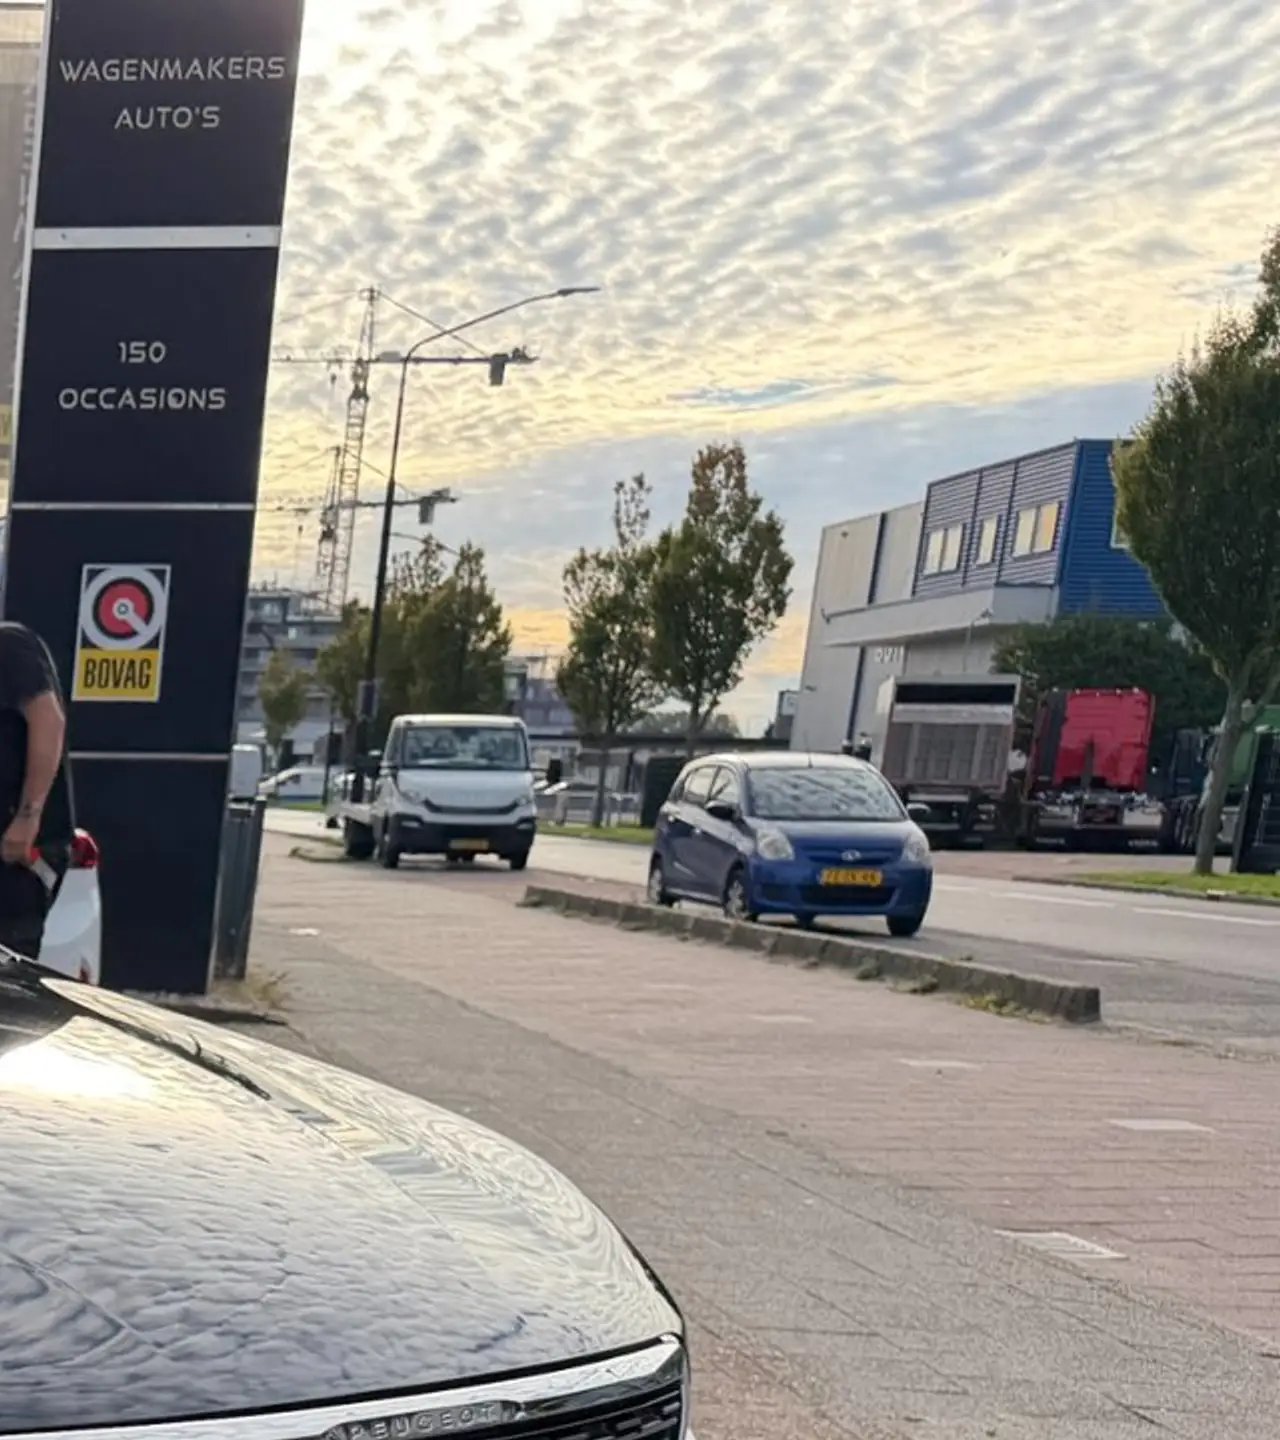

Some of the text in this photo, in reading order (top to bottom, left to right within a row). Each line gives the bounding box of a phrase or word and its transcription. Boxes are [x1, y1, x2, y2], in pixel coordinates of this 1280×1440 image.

[59, 56, 286, 82] WAGENMAKERS
[114, 105, 220, 130] AUTO'S
[117, 340, 167, 364] 150
[58, 387, 227, 411] OCCASIONS
[83, 657, 152, 690] BOVAG
